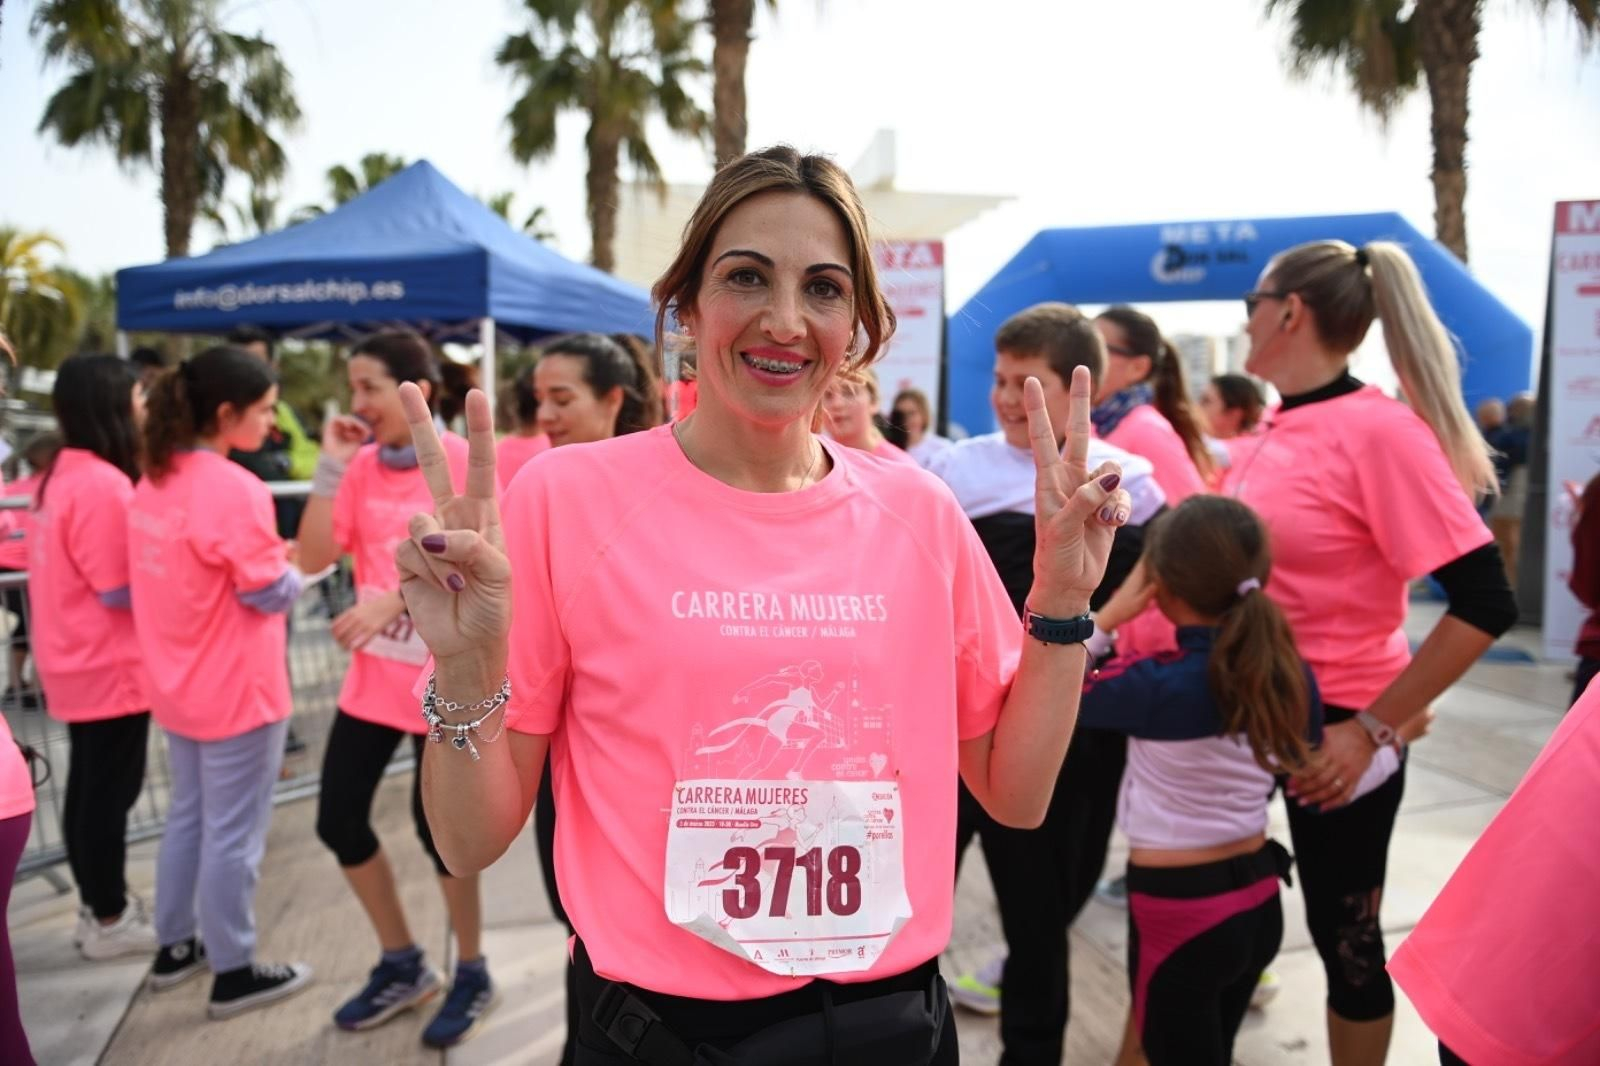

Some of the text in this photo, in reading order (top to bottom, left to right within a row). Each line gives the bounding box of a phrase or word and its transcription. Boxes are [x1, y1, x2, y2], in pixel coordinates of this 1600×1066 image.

[1160, 223, 1257, 243] META
[173, 279, 405, 312] info@dorsalchip.es
[671, 591, 888, 622] CARRERA MUJERES
[719, 625, 757, 636] CONTRA
[759, 626, 769, 636] EL
[773, 624, 808, 638] CÁNCER
[820, 624, 856, 637] MÁLAGA
[677, 786, 809, 805] CARRERA MUJERES
[677, 806, 698, 815] CONTRA
[707, 806, 729, 815] CÁNCER
[734, 806, 758, 815] MÁLAGA
[722, 846, 861, 919] 3718
